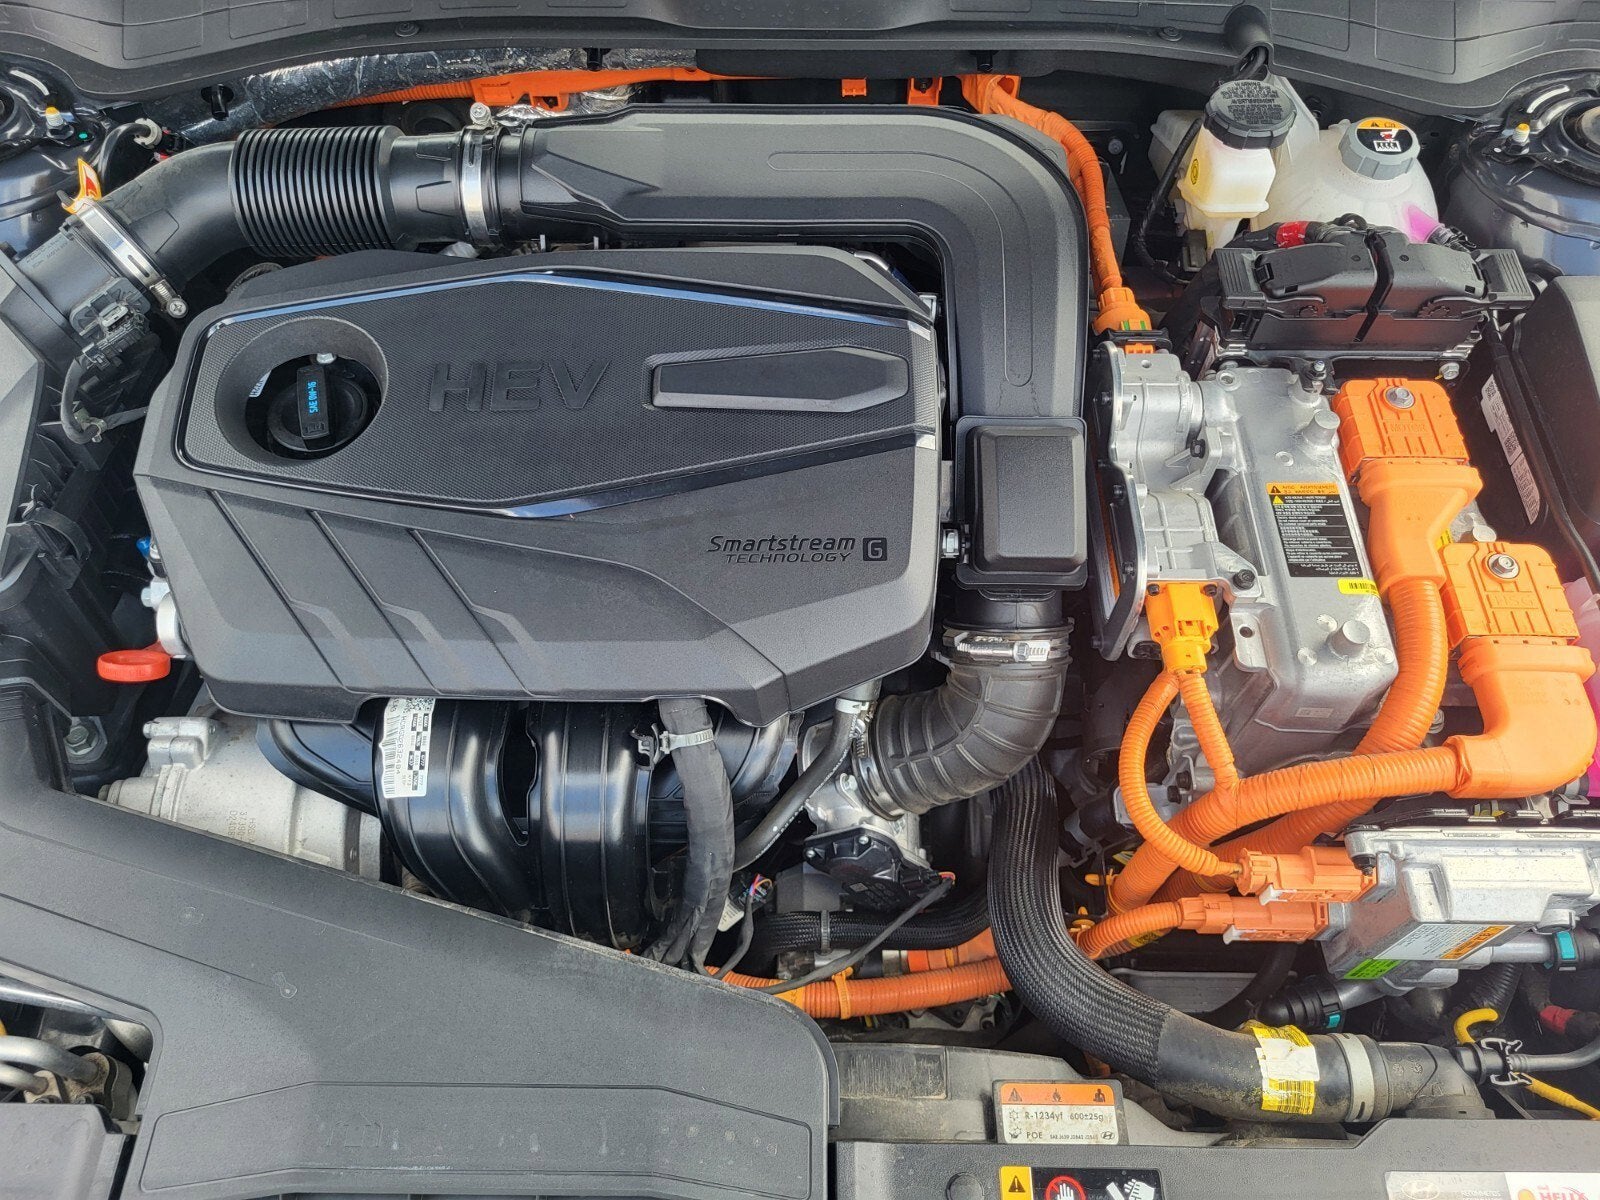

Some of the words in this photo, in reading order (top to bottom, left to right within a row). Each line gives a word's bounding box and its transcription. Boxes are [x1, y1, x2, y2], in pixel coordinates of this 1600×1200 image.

[428, 361, 612, 411] HEV
[308, 400, 319, 416] SAE
[707, 535, 856, 552] Smartstream
[865, 539, 885, 560] G
[725, 552, 851, 564] TECHNOLOGY
[1024, 1111, 1063, 1122] R-1234yf
[1069, 1111, 1104, 1122] 600±25g
[1026, 1131, 1043, 1139] POE
